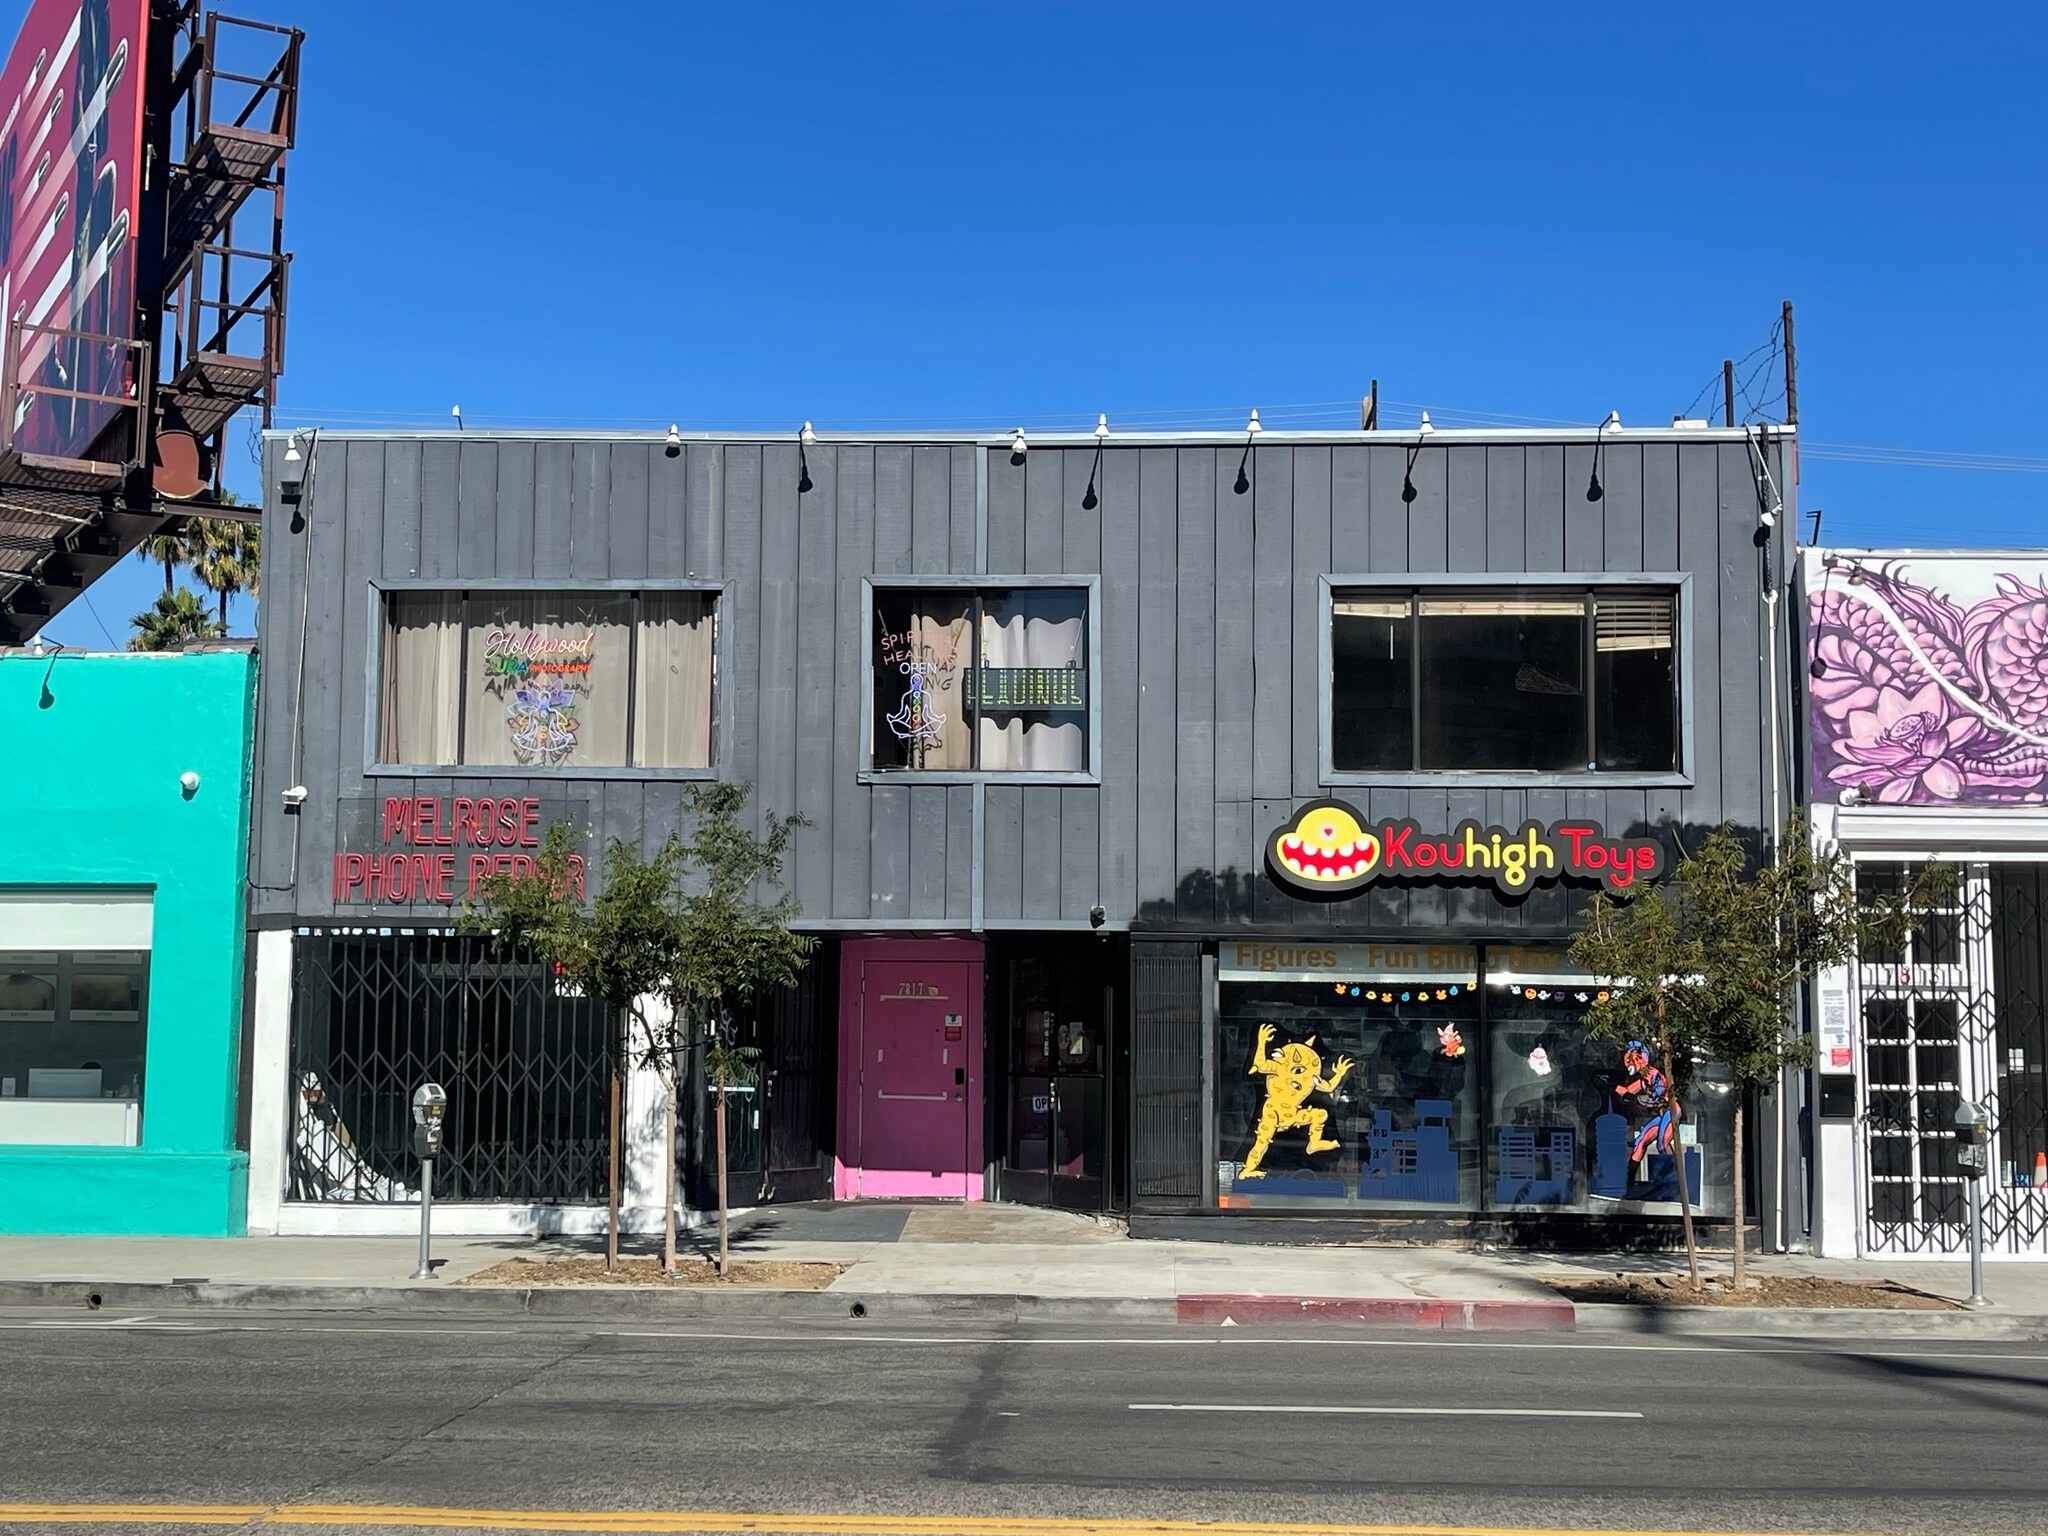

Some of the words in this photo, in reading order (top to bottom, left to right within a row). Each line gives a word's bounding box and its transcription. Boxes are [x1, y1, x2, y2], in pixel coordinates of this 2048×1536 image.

[484, 629, 593, 660] Hollywood
[900, 663, 937, 675] OPEN
[384, 797, 540, 846] MELROSE
[1385, 826, 1554, 886] Kouhigh
[1559, 828, 1655, 887] Toys
[332, 853, 455, 904] IPHONE
[466, 853, 587, 903] REPR
[1236, 943, 1338, 972] Figures
[1369, 944, 1418, 969] Fun
[898, 982, 924, 996] 7817
